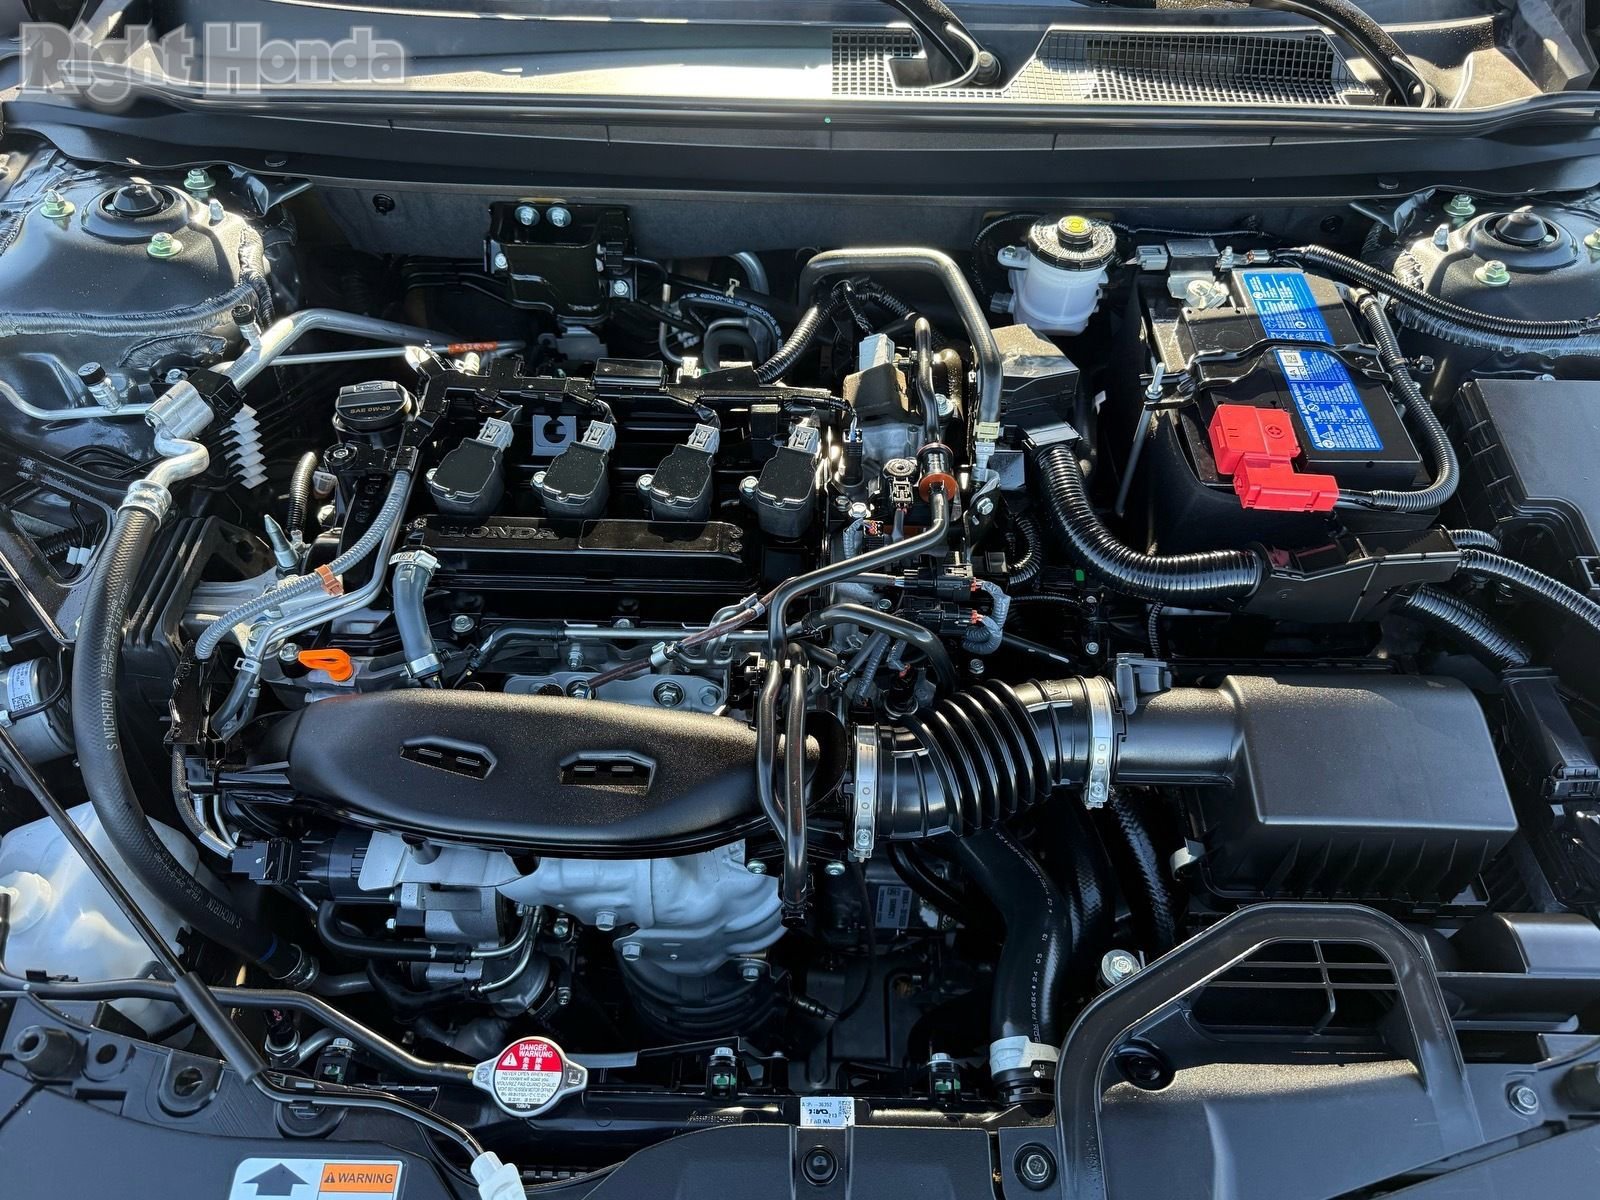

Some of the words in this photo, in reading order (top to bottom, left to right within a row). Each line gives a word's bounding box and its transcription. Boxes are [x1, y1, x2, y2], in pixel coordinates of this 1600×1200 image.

[439, 525, 560, 540] HONDA
[101, 689, 117, 739] NICHIRIN
[519, 1043, 548, 1051] DANGER
[518, 1050, 553, 1058] WARNUNG
[338, 1173, 394, 1184] WARNING
